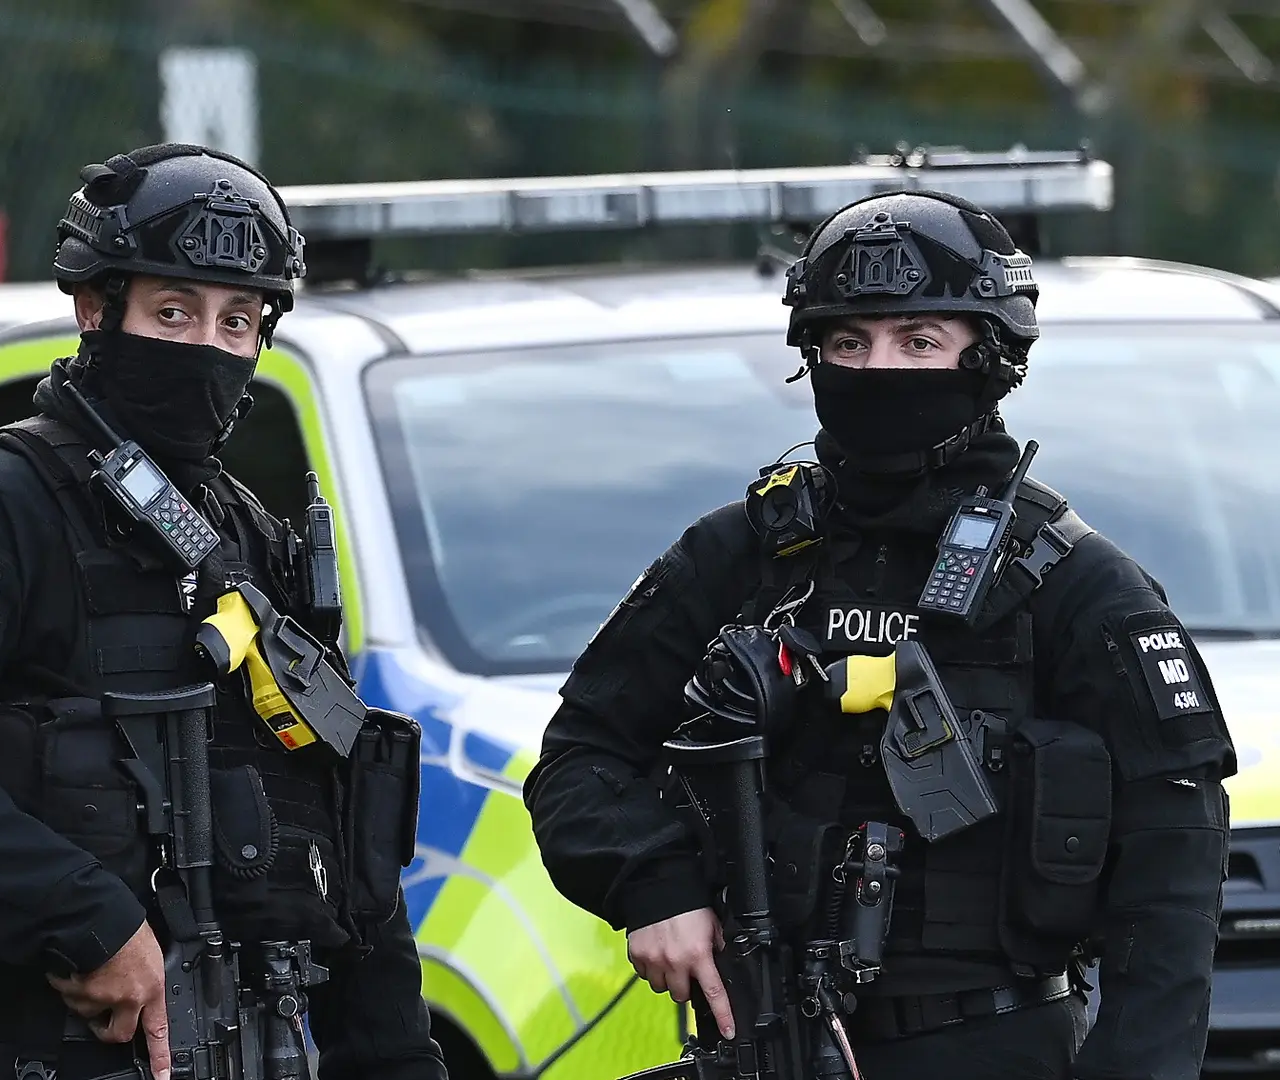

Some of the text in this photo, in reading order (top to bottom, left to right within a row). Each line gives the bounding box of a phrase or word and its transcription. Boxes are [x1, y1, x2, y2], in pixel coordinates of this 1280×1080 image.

[827, 608, 920, 646] POLICE
[1138, 631, 1186, 653] POLICE
[1157, 658, 1190, 685] MD
